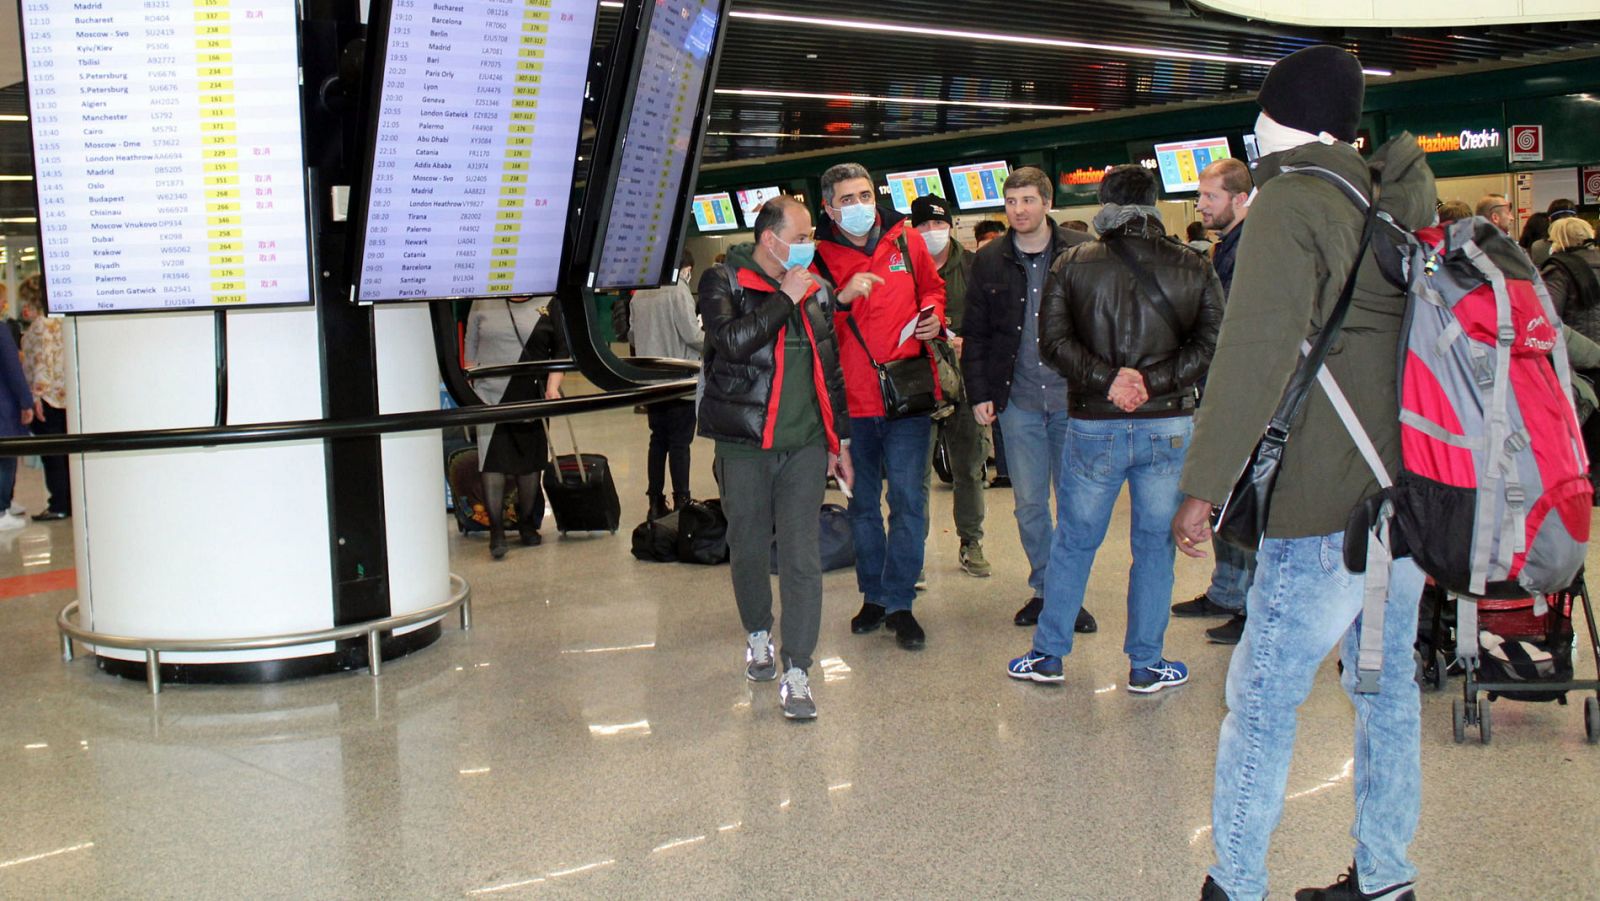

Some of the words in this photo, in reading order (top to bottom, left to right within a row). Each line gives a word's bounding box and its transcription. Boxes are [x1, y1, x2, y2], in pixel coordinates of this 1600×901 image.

[397, 0, 414, 8] 18:55
[434, 4, 464, 12] Bucharest
[432, 17, 462, 25] Barcelona
[77, 45, 112, 53] Kyiv/Kiev
[442, 71, 454, 79] Orly
[424, 83, 438, 91] Lyon
[1417, 132, 1459, 153] ttazione
[1459, 128, 1500, 151] Check-in
[1140, 158, 1158, 169] 168
